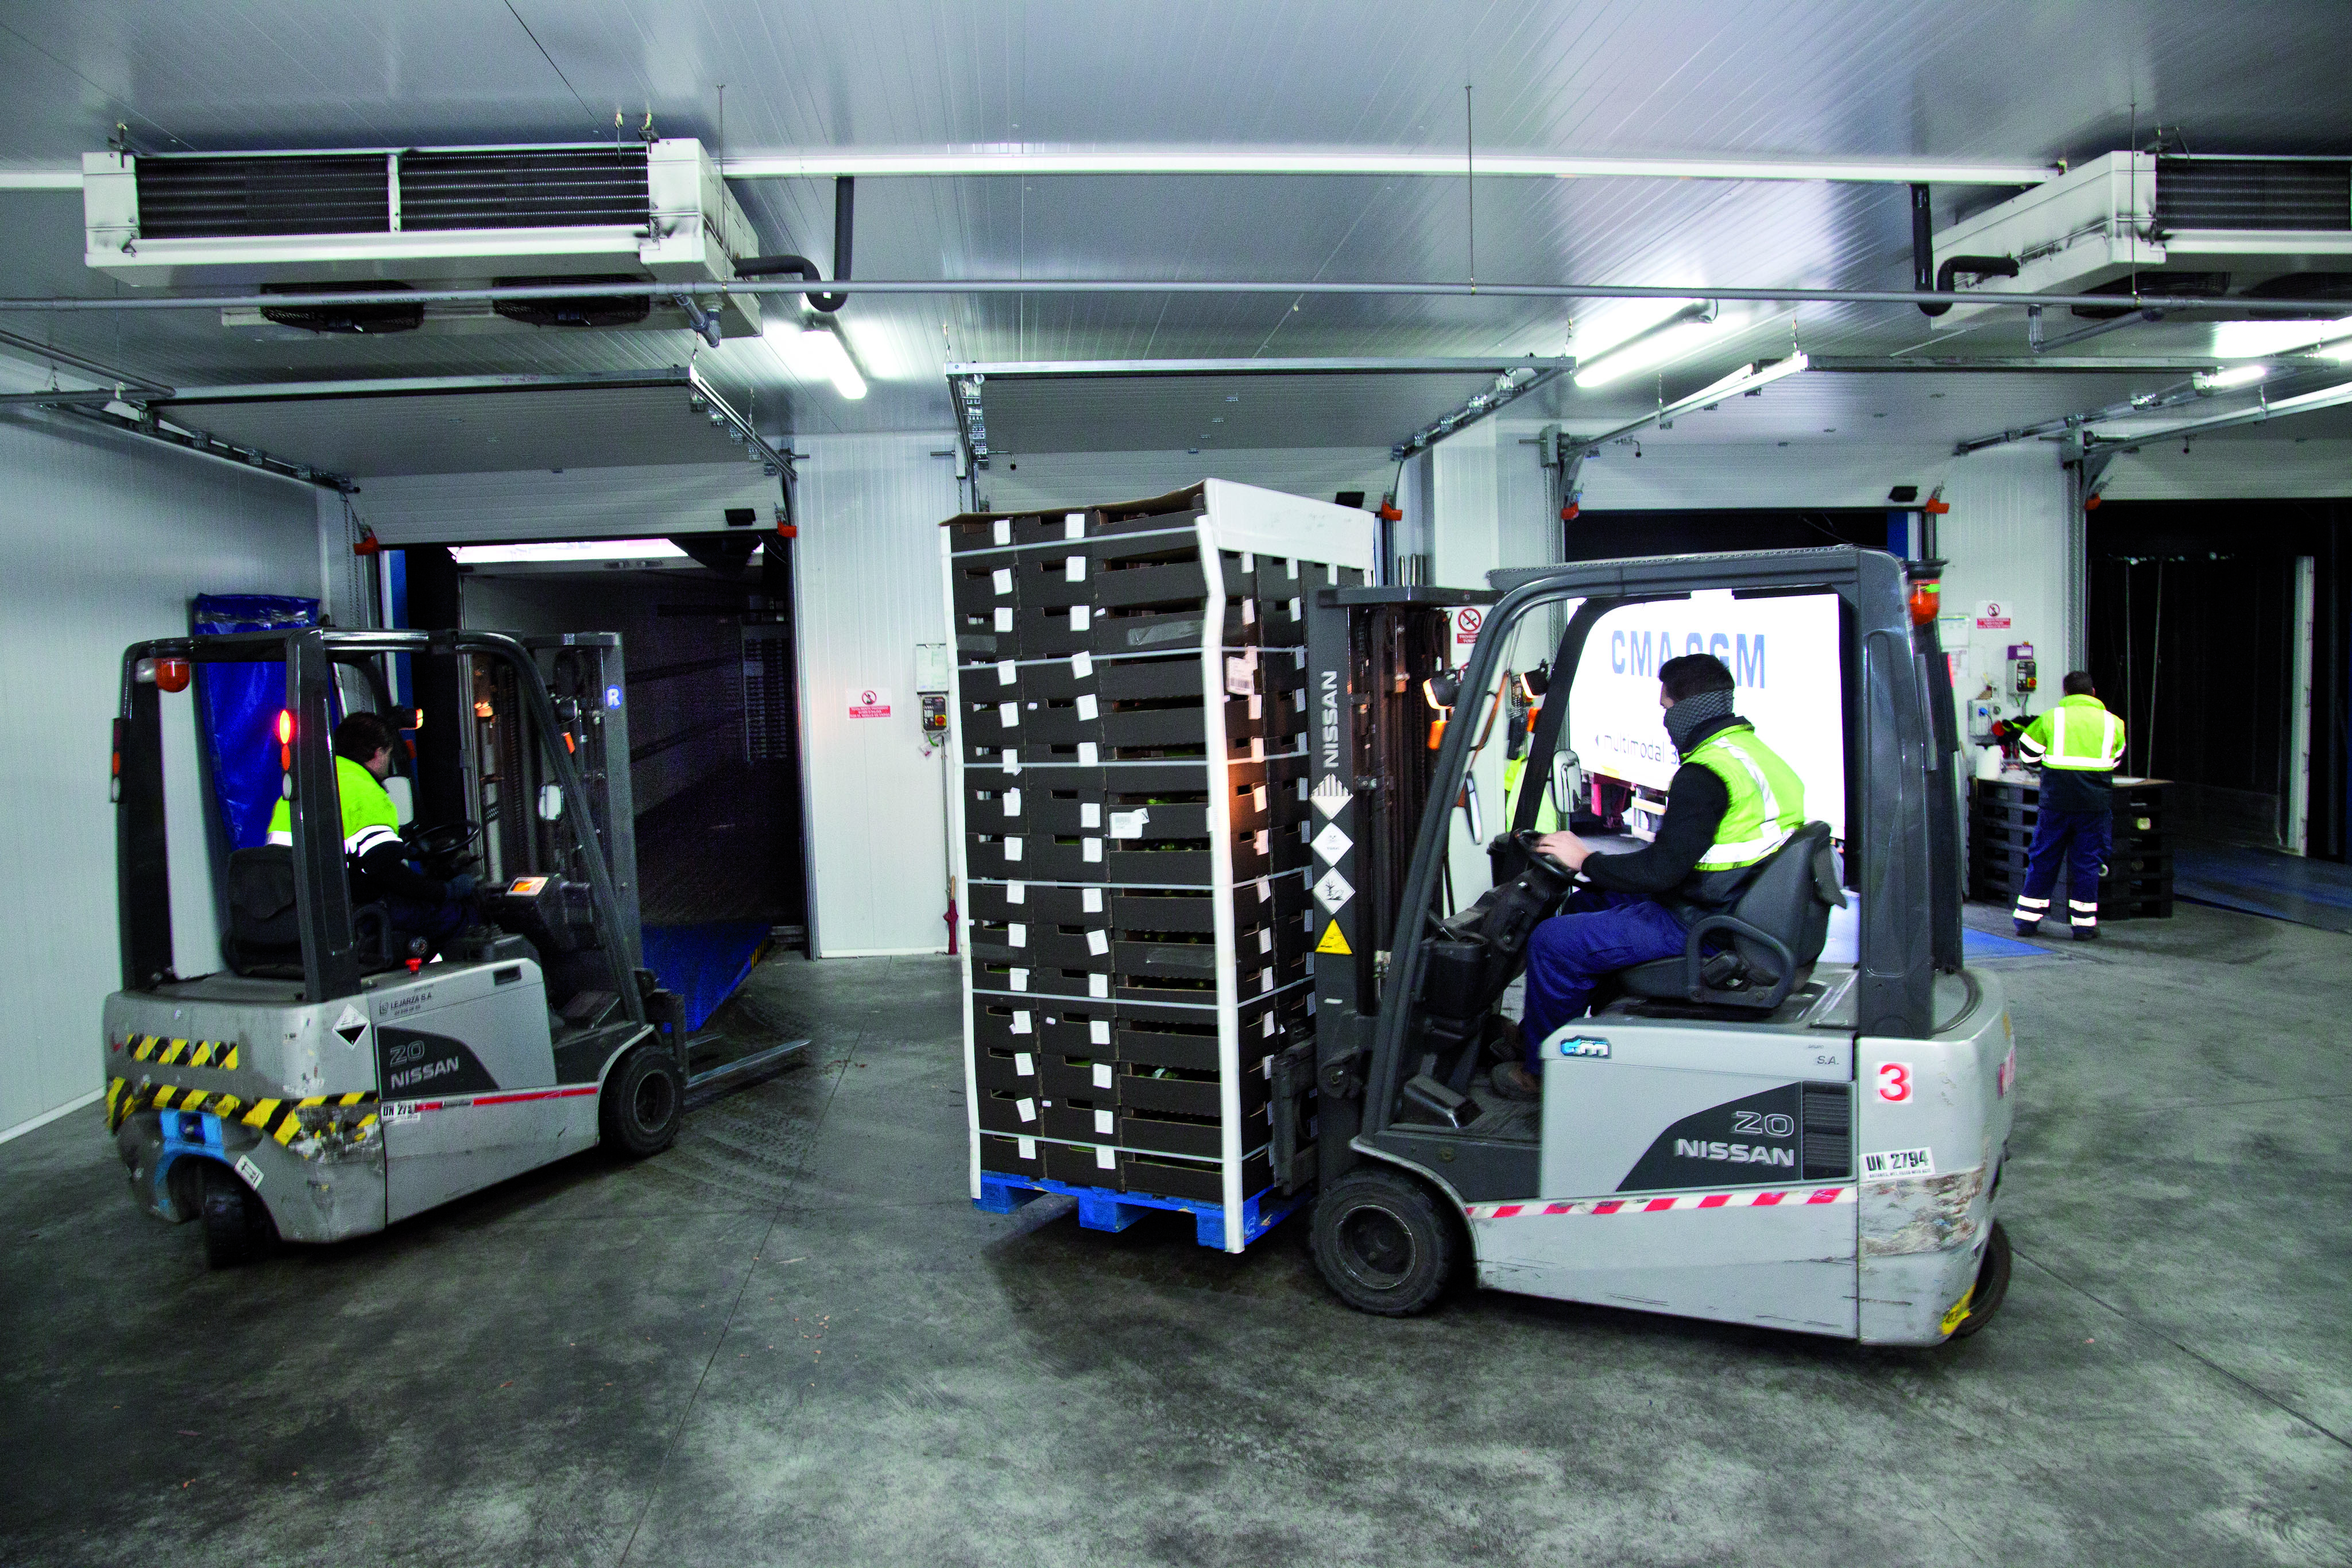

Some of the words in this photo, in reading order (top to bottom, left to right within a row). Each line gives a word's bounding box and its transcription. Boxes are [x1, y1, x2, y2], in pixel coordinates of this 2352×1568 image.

[1611, 630, 1673, 678] CMA
[606, 688, 621, 707] R
[1321, 671, 1339, 768] NISSAN
[1604, 731, 1665, 764] multimodal
[390, 1040, 425, 1067] 20
[1817, 1055, 1840, 1065] S.A.
[390, 1055, 459, 1090] NISSAN
[1879, 1062, 1912, 1101] 3
[1733, 1110, 1794, 1137] 20
[1673, 1138, 1794, 1167] NISSAN
[1866, 1153, 1887, 1171] UN
[1890, 1149, 1930, 1169] 2794
